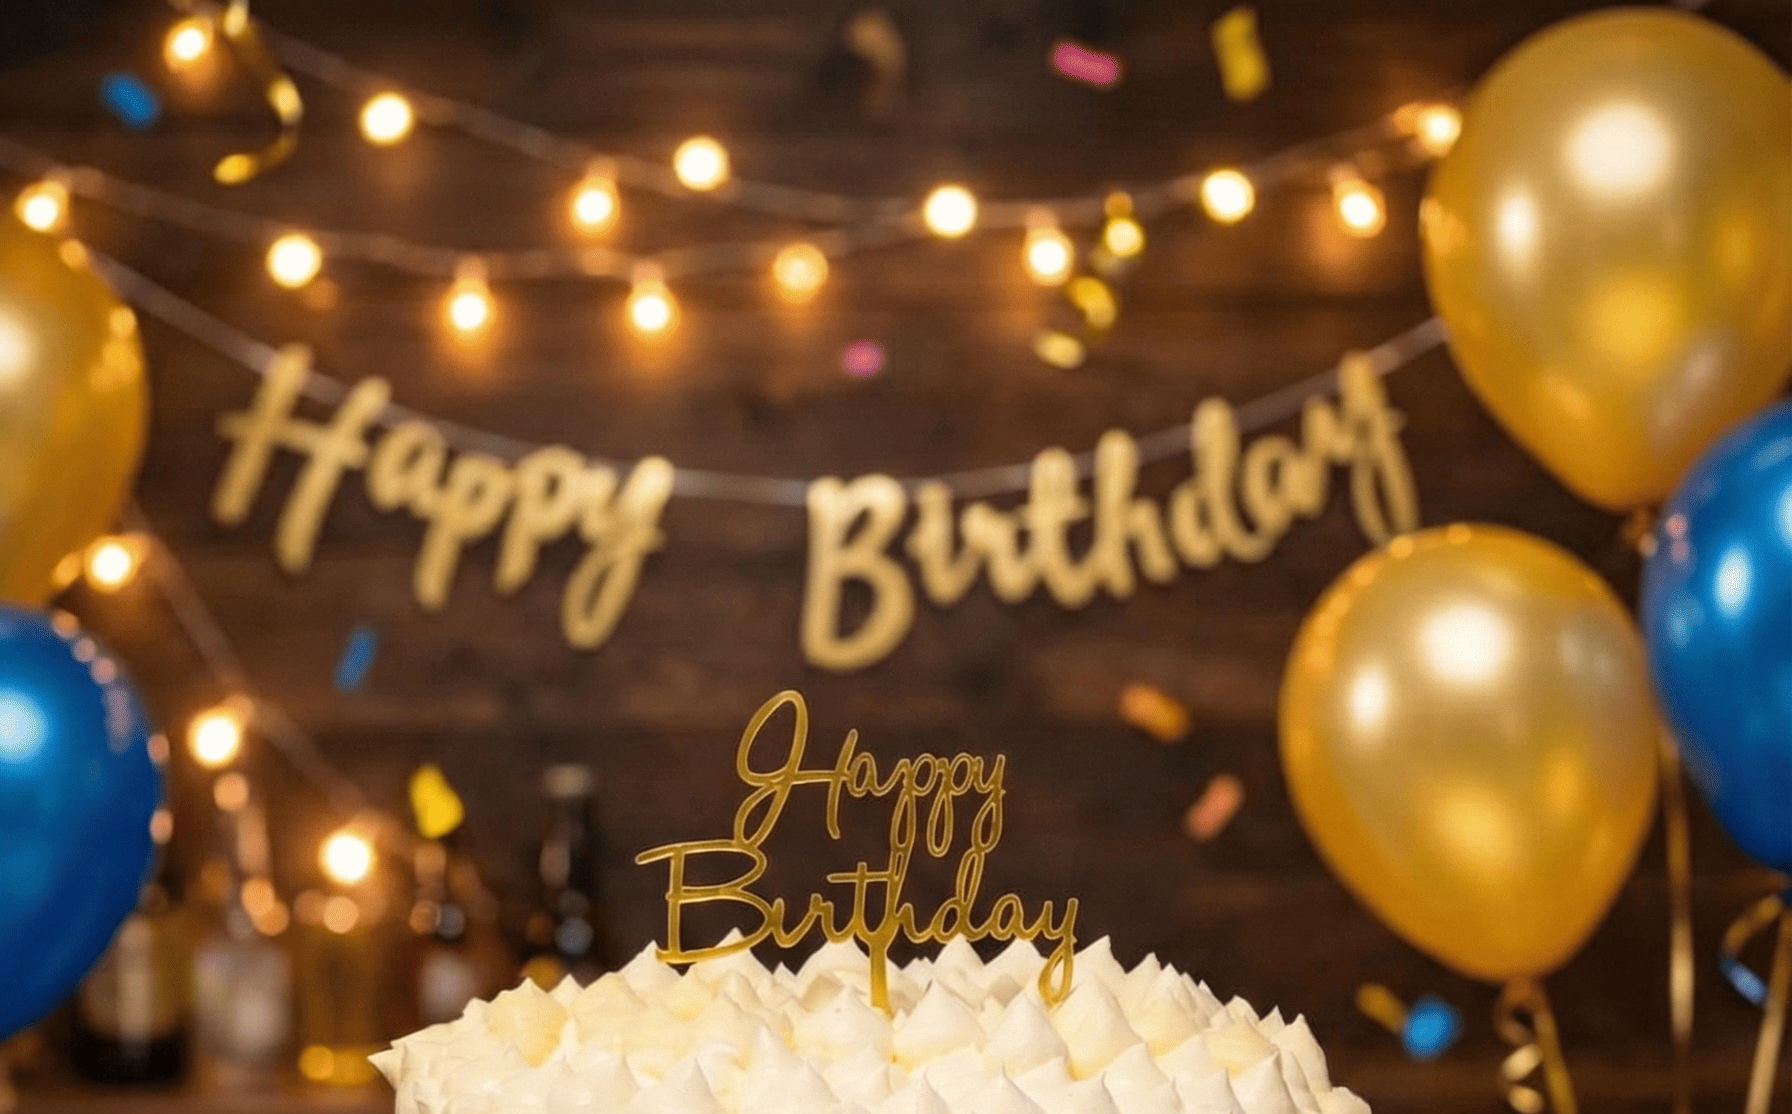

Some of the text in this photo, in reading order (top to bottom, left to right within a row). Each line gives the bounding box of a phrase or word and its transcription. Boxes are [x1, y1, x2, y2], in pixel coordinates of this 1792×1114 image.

[211, 343, 1420, 671] Happy Birthday
[734, 690, 1006, 857] Happy
[635, 840, 1079, 1007] Birthday
